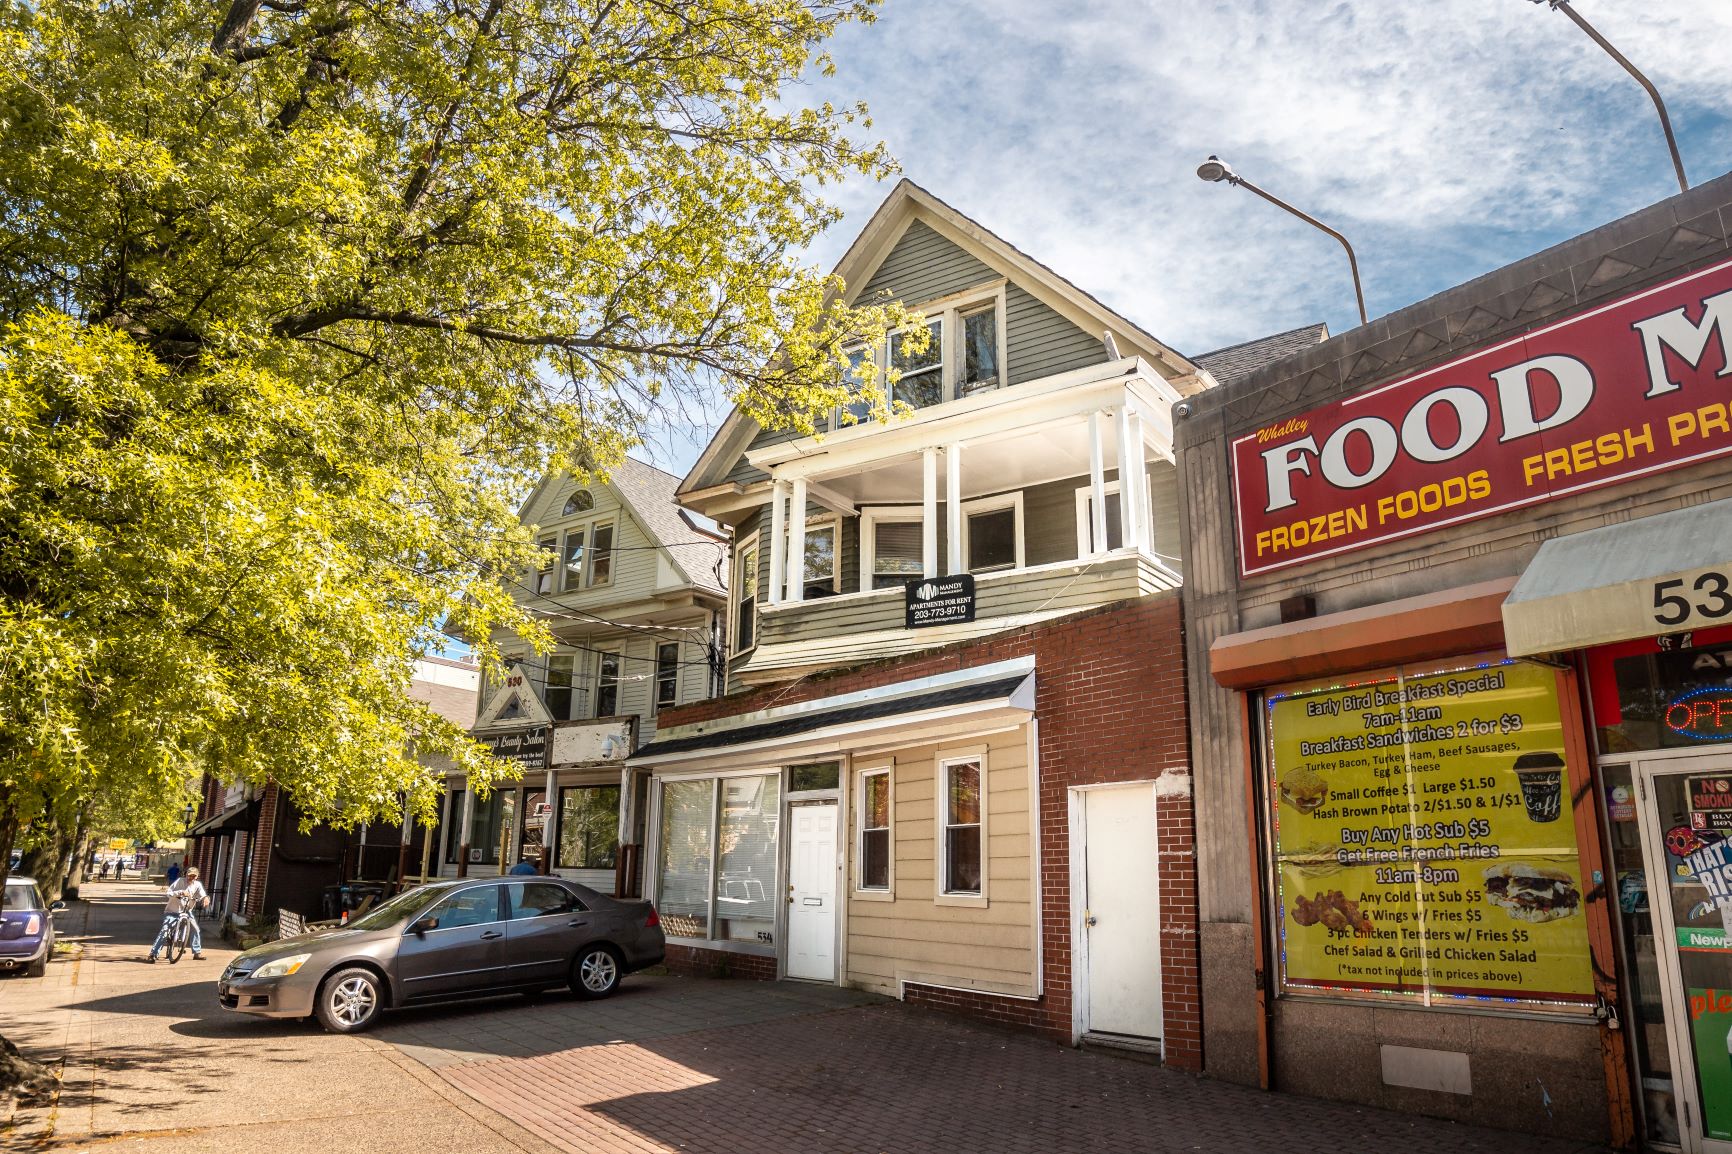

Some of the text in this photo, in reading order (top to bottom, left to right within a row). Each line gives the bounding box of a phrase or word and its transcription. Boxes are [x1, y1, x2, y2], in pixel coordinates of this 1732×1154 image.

[1256, 418, 1308, 443] Whalley
[1260, 353, 1596, 514] FOOD
[1256, 400, 1732, 557] FROZEN FOODS FRESH PR
[940, 582, 962, 591] MANDY
[909, 596, 972, 610] APARTMENTS FOR RENT
[914, 605, 966, 619] 203-773-9710
[1307, 671, 1505, 717] Early Bird Breakfast Special
[1362, 706, 1442, 728] 7am-11am
[501, 735, 522, 752] Beauty
[523, 729, 545, 746] Salon
[1301, 712, 1523, 757] Breakfast Sandwiches 2 for $3
[1306, 741, 1521, 772] Turkey Bacon, Turkey Ham, Beef Sausages,
[1373, 762, 1441, 778] Egg & Cheese
[1330, 777, 1496, 801] Small Coffee $1 Large $1.50
[1313, 793, 1522, 819] Hash Brown Potato 2/$1.50 & 1/$1
[1341, 817, 1490, 846] Buy Any Hot Sub $5
[1337, 841, 1500, 863] Get Free French Fries
[1375, 866, 1459, 886] 11am-8pm
[1360, 889, 1482, 905] Any Cold Cut Sub $5
[1362, 908, 1482, 923] 6 Wings w/ Fries $5
[1327, 927, 1529, 943] 3 pc Chicken Tenders w/ Fries $5
[1324, 944, 1537, 962] Chef Salad & Grilled Chicken Salad
[1365, 966, 1383, 975] not
[1385, 966, 1429, 977] included
[1433, 968, 1443, 977] in
[1446, 969, 1479, 980] prices
[1482, 970, 1522, 984] above)
